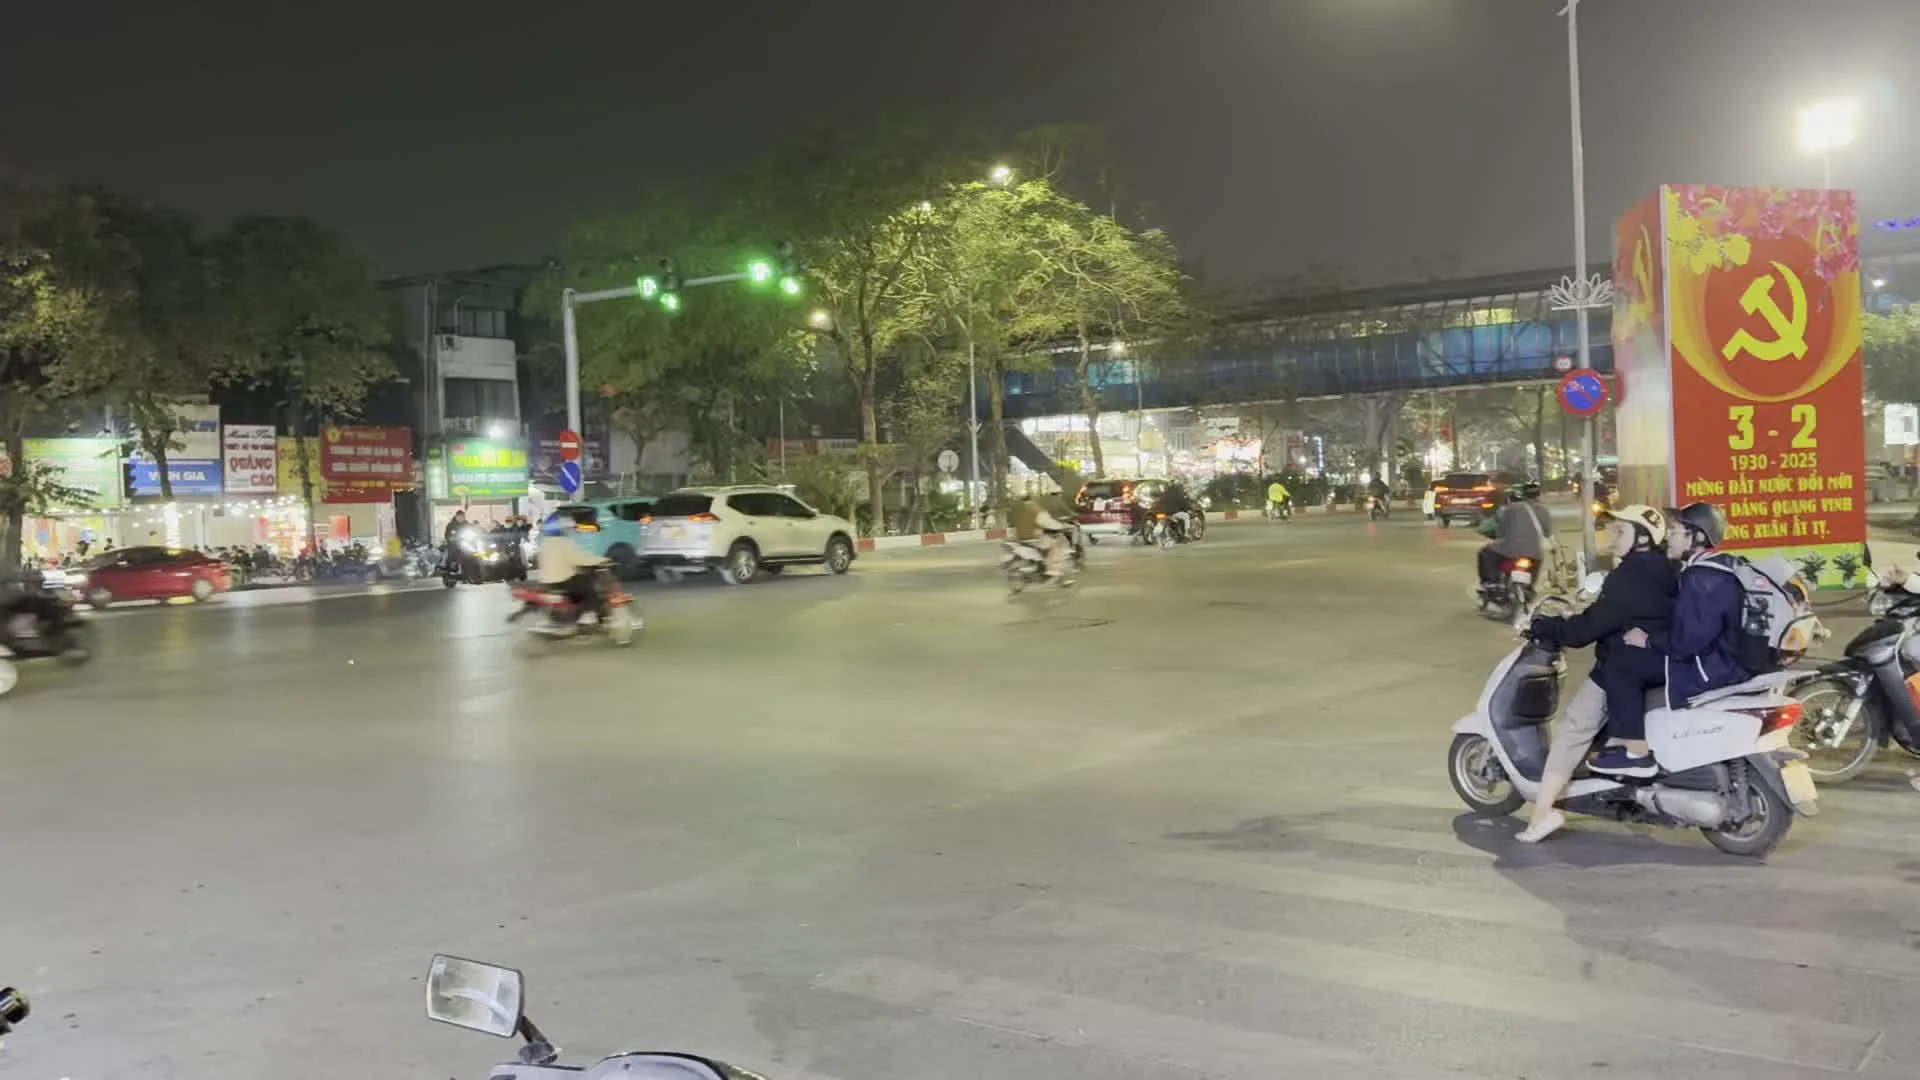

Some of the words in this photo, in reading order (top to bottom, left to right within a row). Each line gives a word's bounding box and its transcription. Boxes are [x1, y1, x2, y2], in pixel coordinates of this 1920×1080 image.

[1728, 405, 1755, 450] 3
[1791, 404, 1817, 449] 2
[1730, 454, 1767, 471] 1930
[1779, 452, 1817, 469] 2025
[183, 472, 206, 481] GIA
[1686, 477, 1724, 496] MỪNG
[1772, 499, 1816, 518] QUANG
[1822, 497, 1853, 512] VINH
